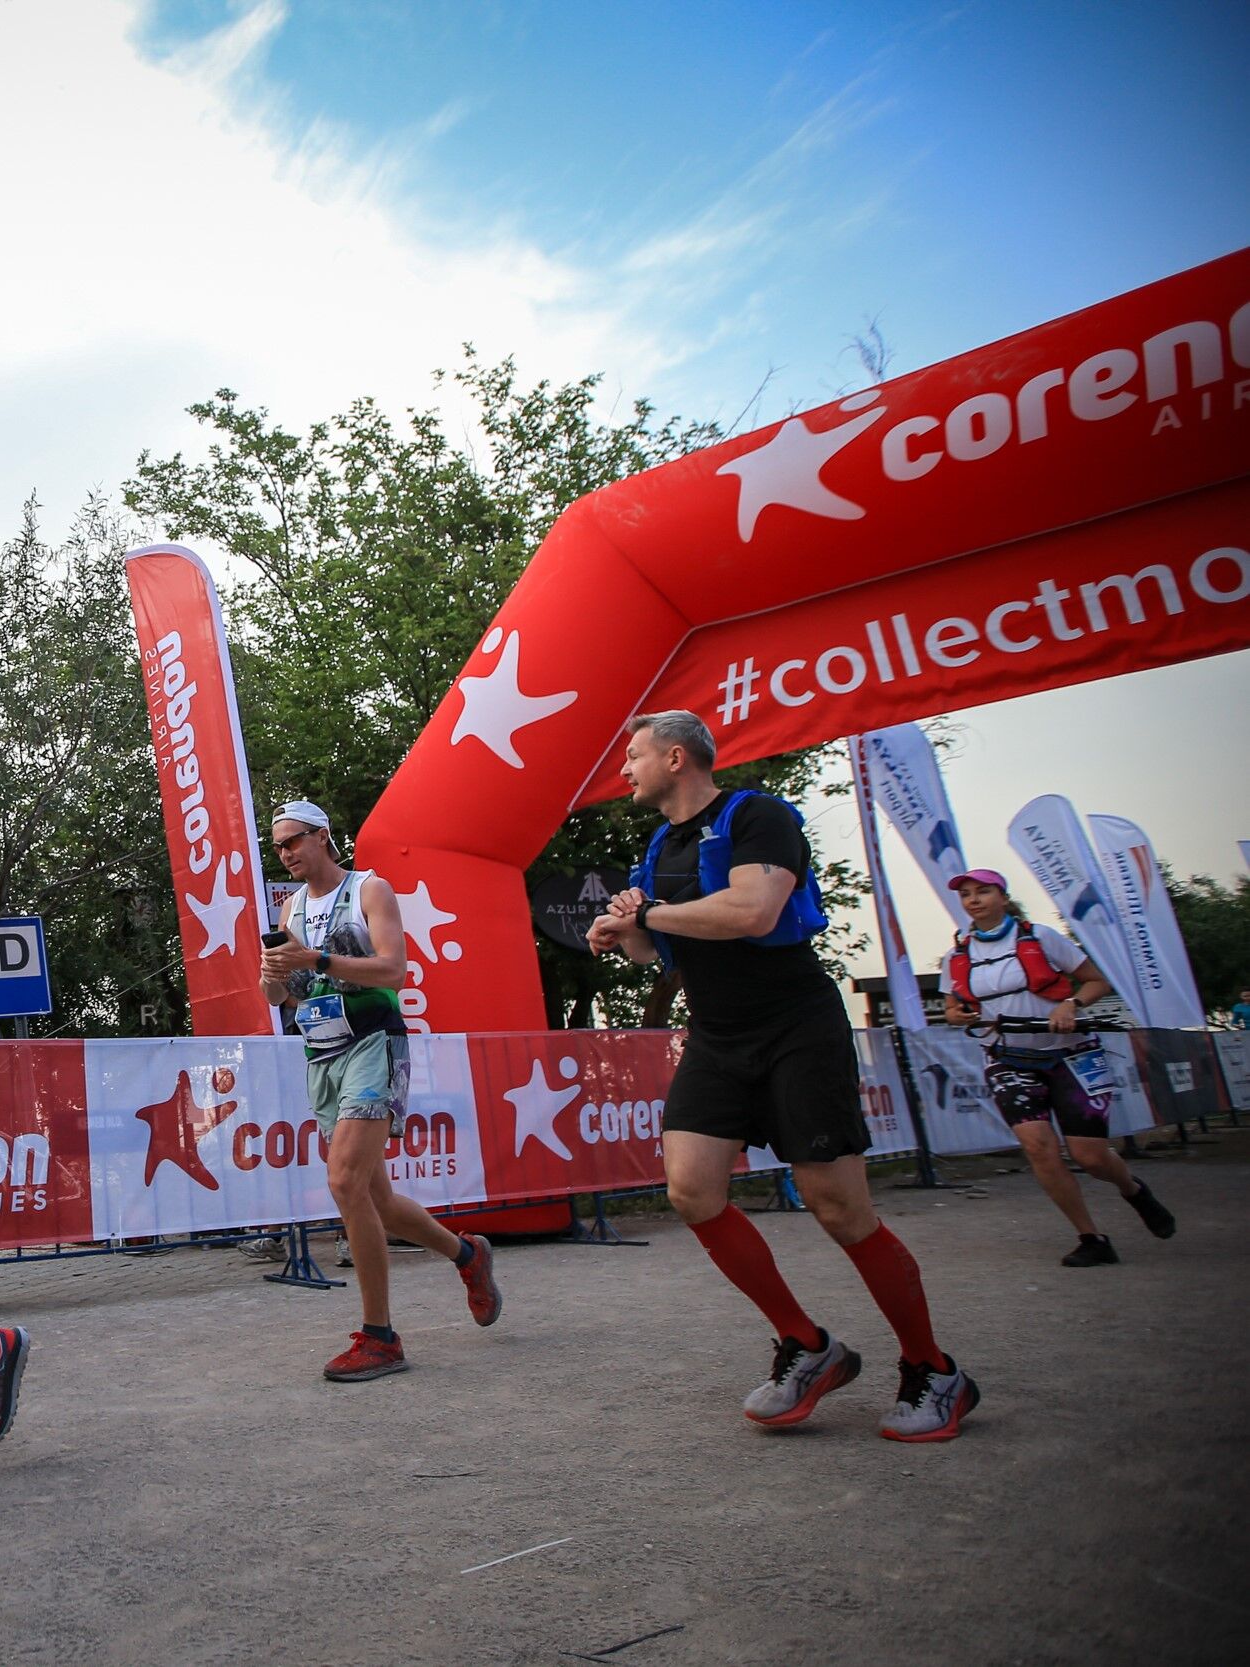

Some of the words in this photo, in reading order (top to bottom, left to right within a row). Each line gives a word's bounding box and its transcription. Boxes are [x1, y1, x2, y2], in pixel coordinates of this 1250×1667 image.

[716, 546, 1250, 726] #collectmo
[546, 904, 588, 914] AZUR
[140, 1005, 158, 1026] R
[579, 1099, 665, 1144] coren
[390, 1158, 457, 1181] LINES
